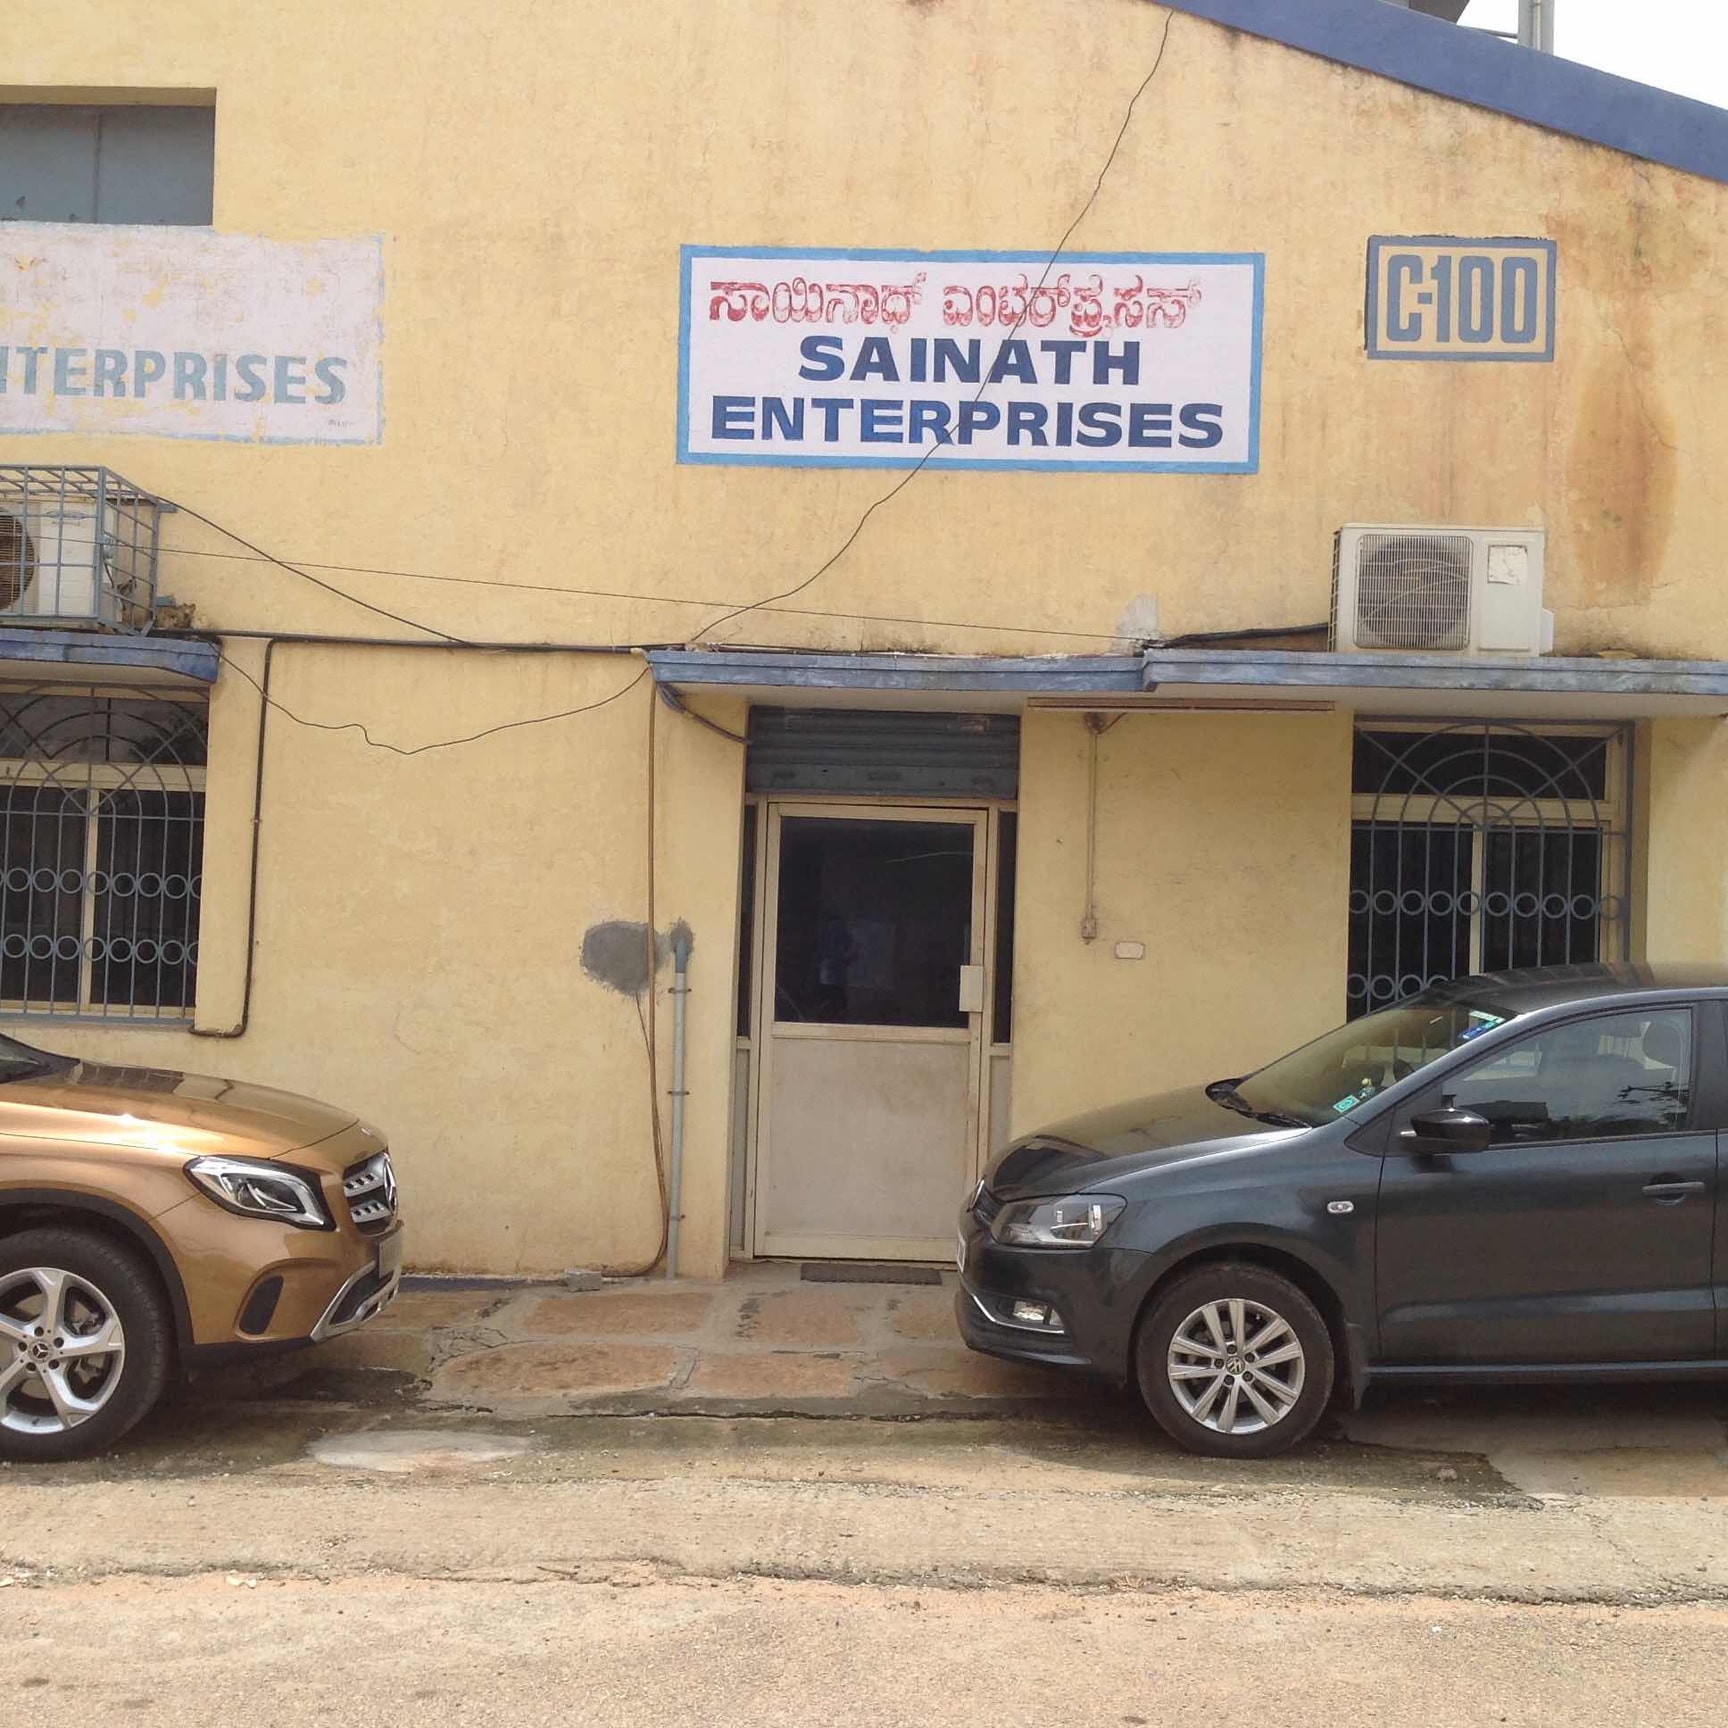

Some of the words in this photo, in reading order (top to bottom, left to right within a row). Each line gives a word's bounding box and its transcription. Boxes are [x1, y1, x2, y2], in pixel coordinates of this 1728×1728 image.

[1386, 254, 1539, 344] C-100
[799, 335, 1140, 386] SAINATH
[711, 395, 1223, 449] ENTERPRISES
